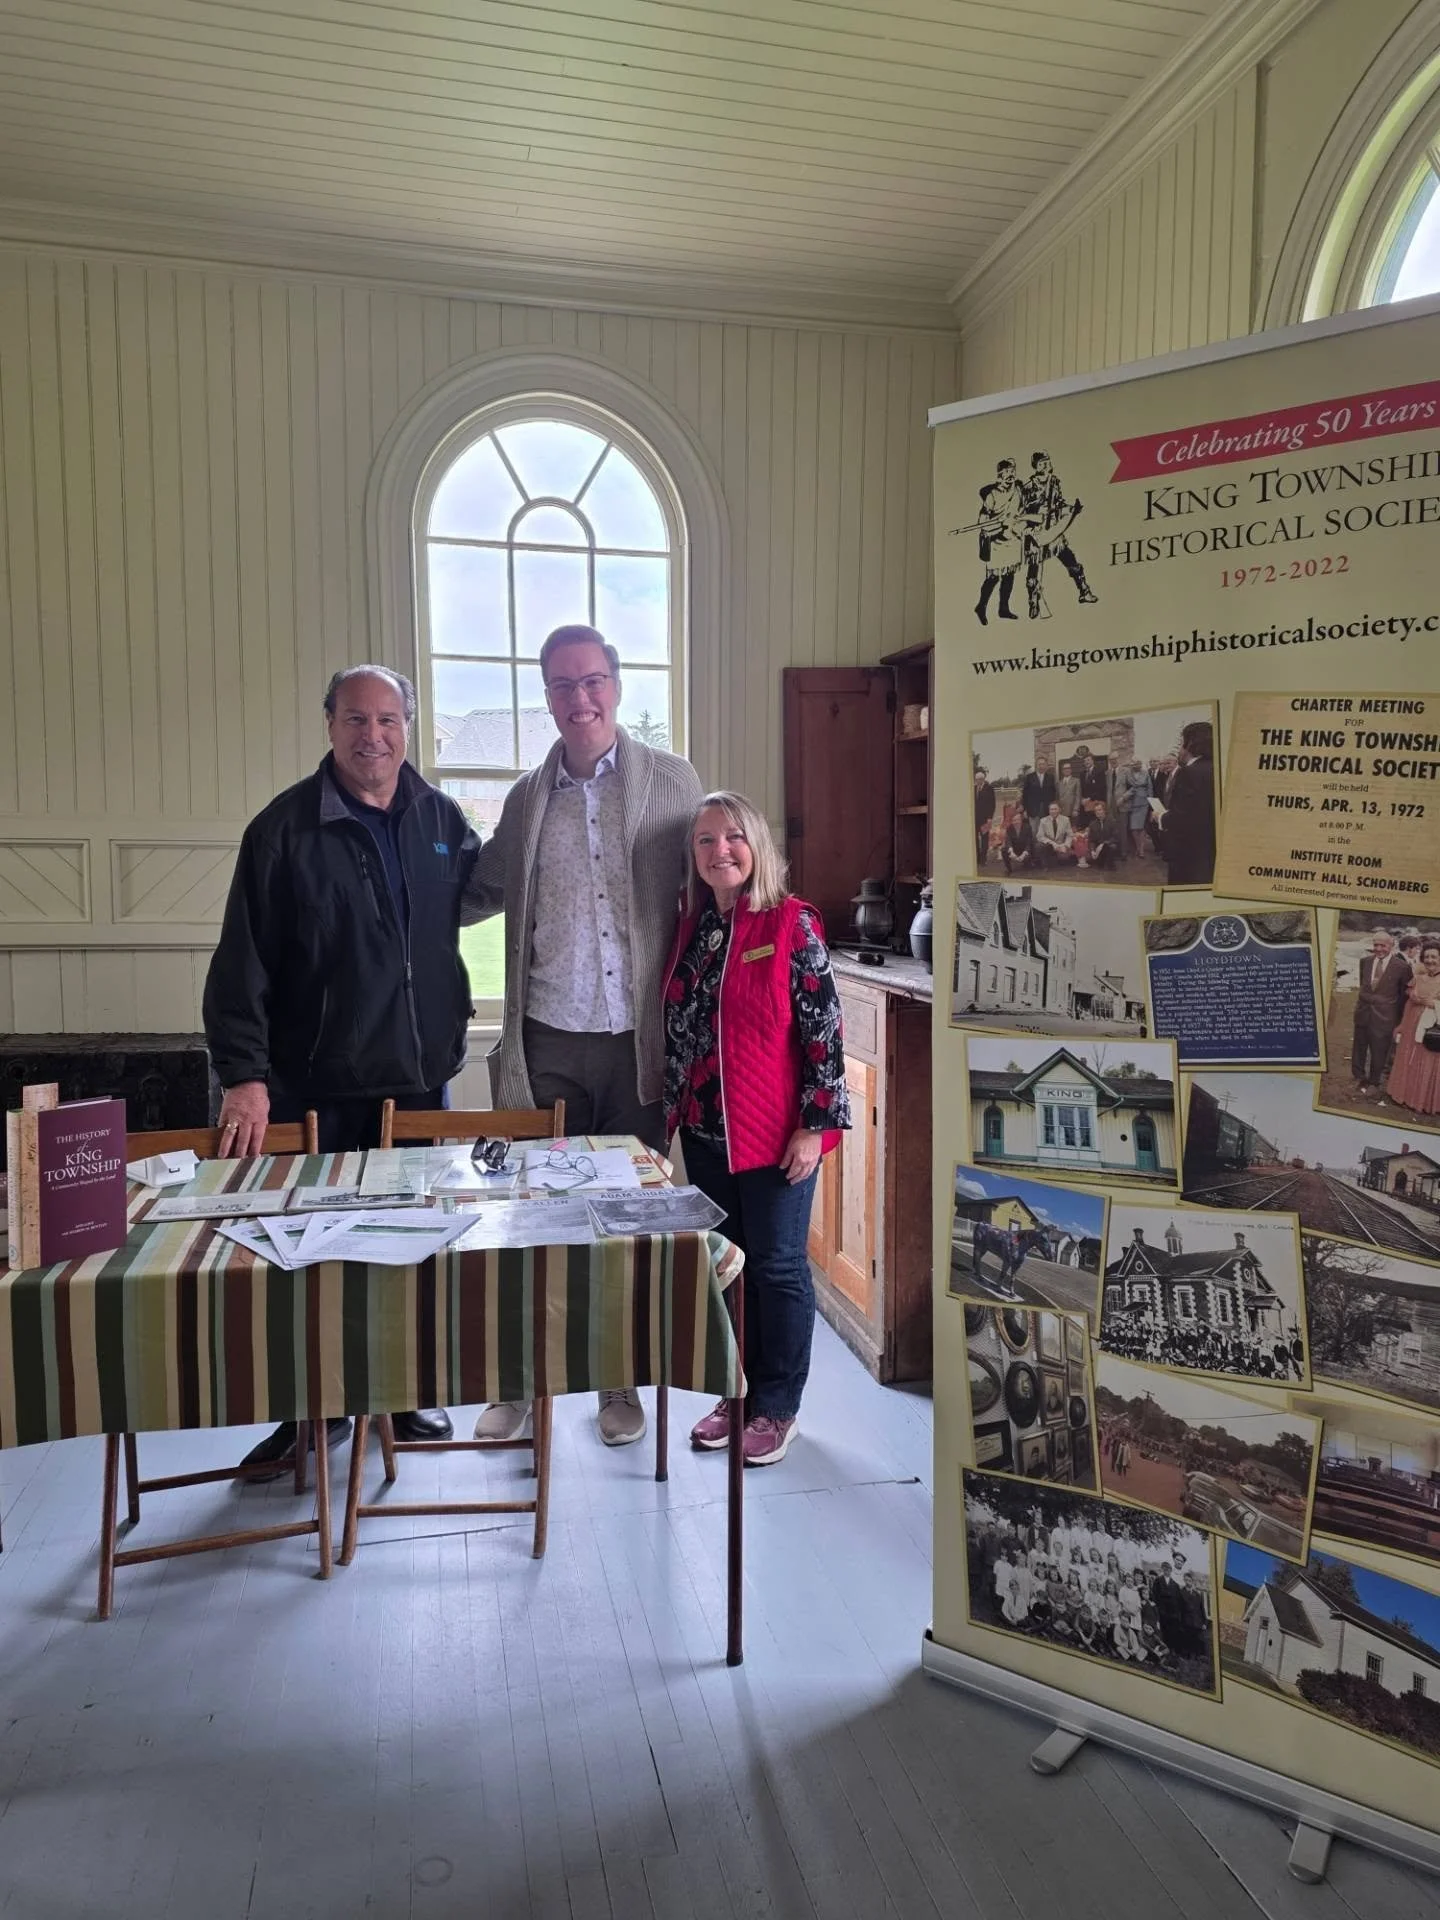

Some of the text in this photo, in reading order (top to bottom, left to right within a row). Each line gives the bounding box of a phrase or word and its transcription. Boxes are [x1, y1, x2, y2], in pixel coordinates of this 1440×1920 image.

[1156, 399, 1437, 465] Celebrating 50 Years
[1144, 483, 1240, 521] KING
[1109, 514, 1315, 567] HISTORICAL
[1220, 554, 1350, 589] 1972-2022
[1291, 698, 1425, 715] CHARTER MEETING
[1344, 718, 1365, 727] FOR
[1261, 729, 1440, 752] THE KING TOWNSH
[1258, 754, 1363, 775] HISTORICAL
[1322, 783, 1369, 792] will be held
[1267, 794, 1425, 818] THURS, APR. 13, 1972
[1328, 836, 1351, 845] in the
[1290, 849, 1382, 868] INSTITUTE ROOM
[1248, 866, 1430, 894] COMMUNITY HALL, SCHOMBERG
[1271, 884, 1399, 905] All interested persons welcome
[1194, 954, 1262, 966] LLOYDTOWN
[56, 1128, 111, 1144] THE HISTORY
[65, 1149, 102, 1166] KING
[44, 1158, 121, 1182] TOWNSHIP
